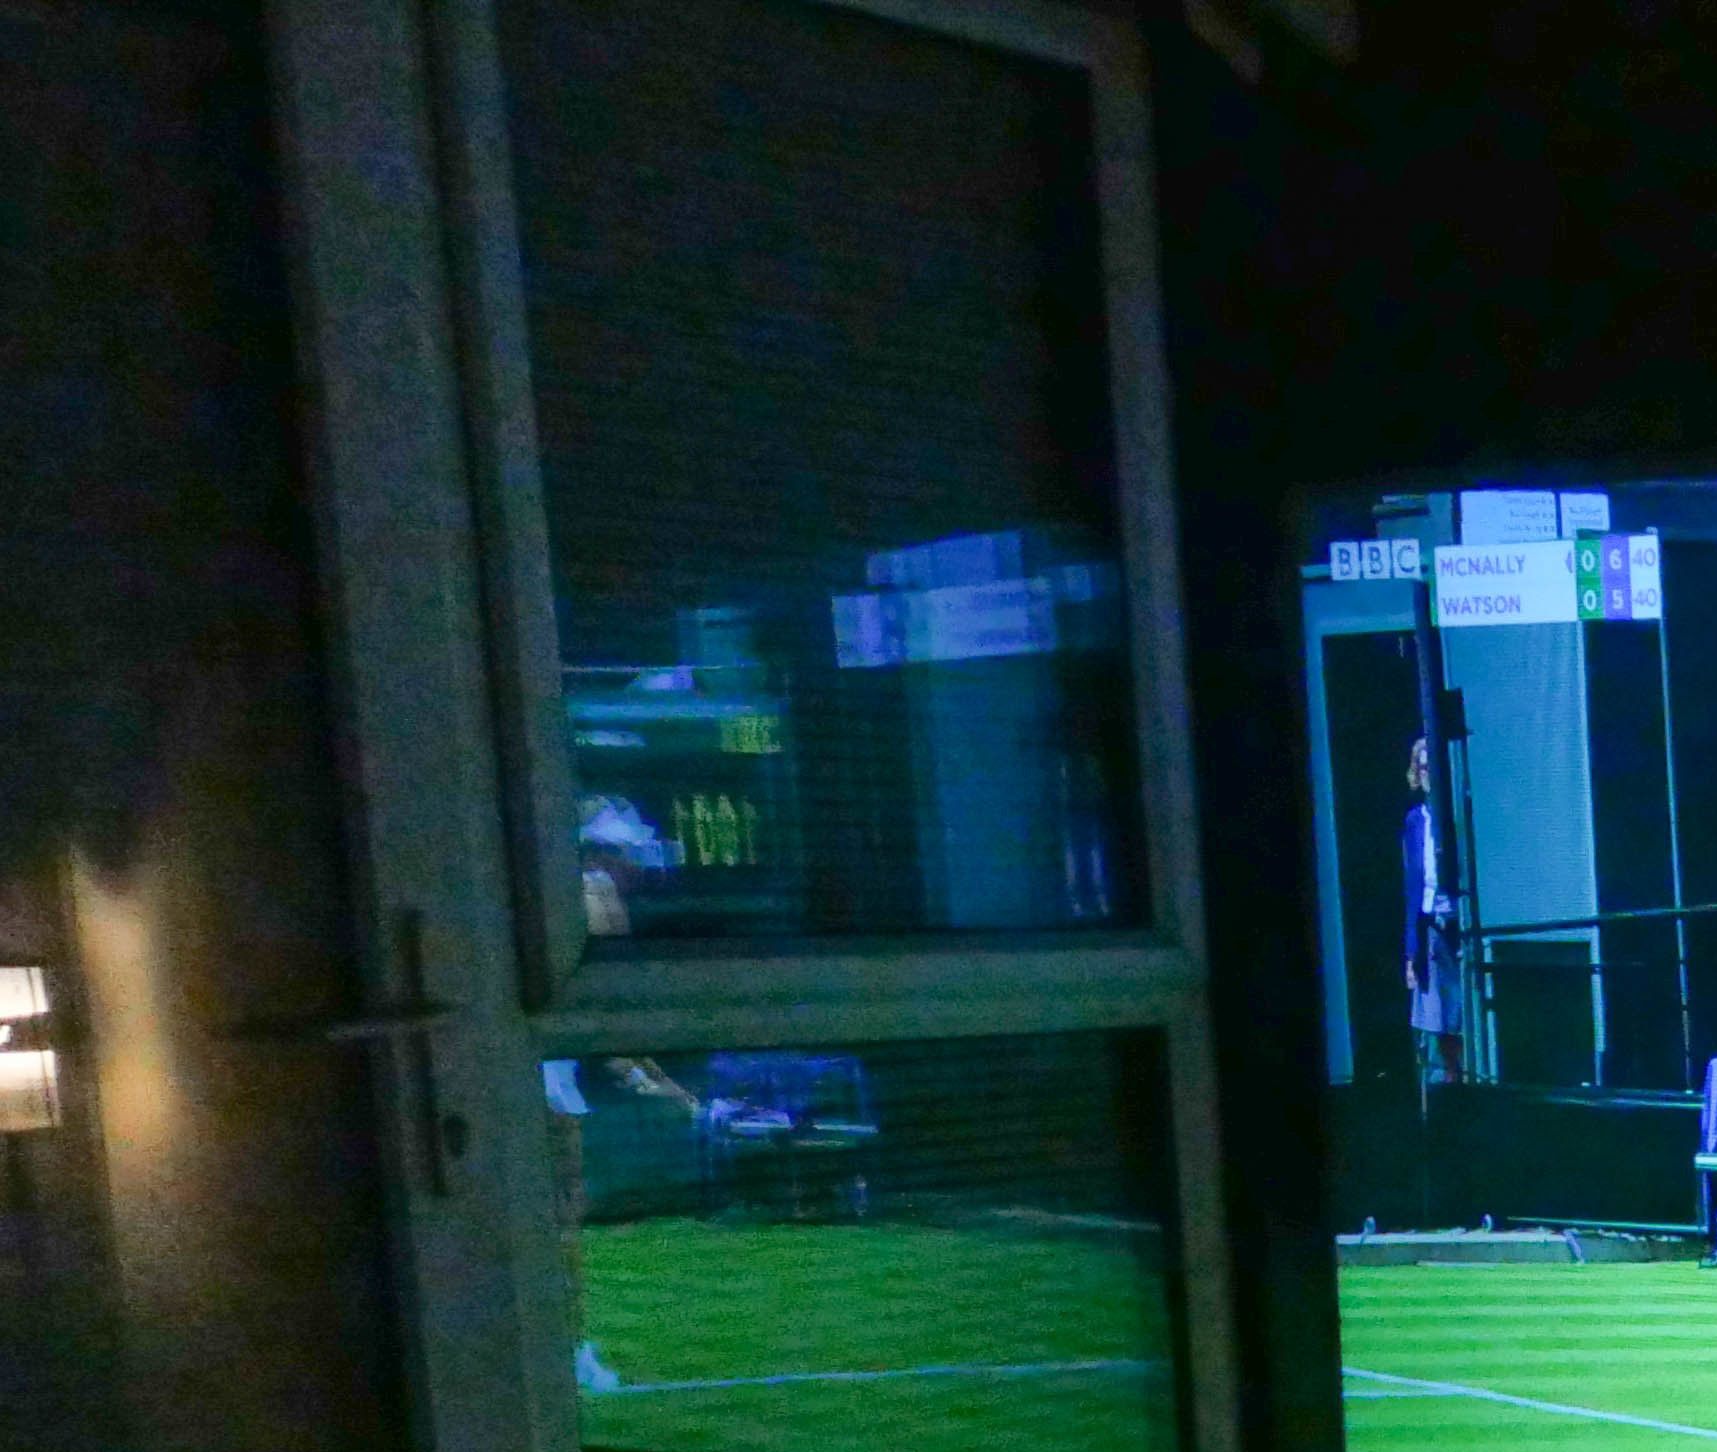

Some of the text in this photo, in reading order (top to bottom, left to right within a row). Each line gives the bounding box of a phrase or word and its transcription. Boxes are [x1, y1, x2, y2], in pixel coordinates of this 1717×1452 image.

[1337, 547, 1417, 578] BBC
[1440, 548, 1656, 577] MCNALLY 0 6 40
[1442, 587, 1657, 615] WATSON 0 5 40
